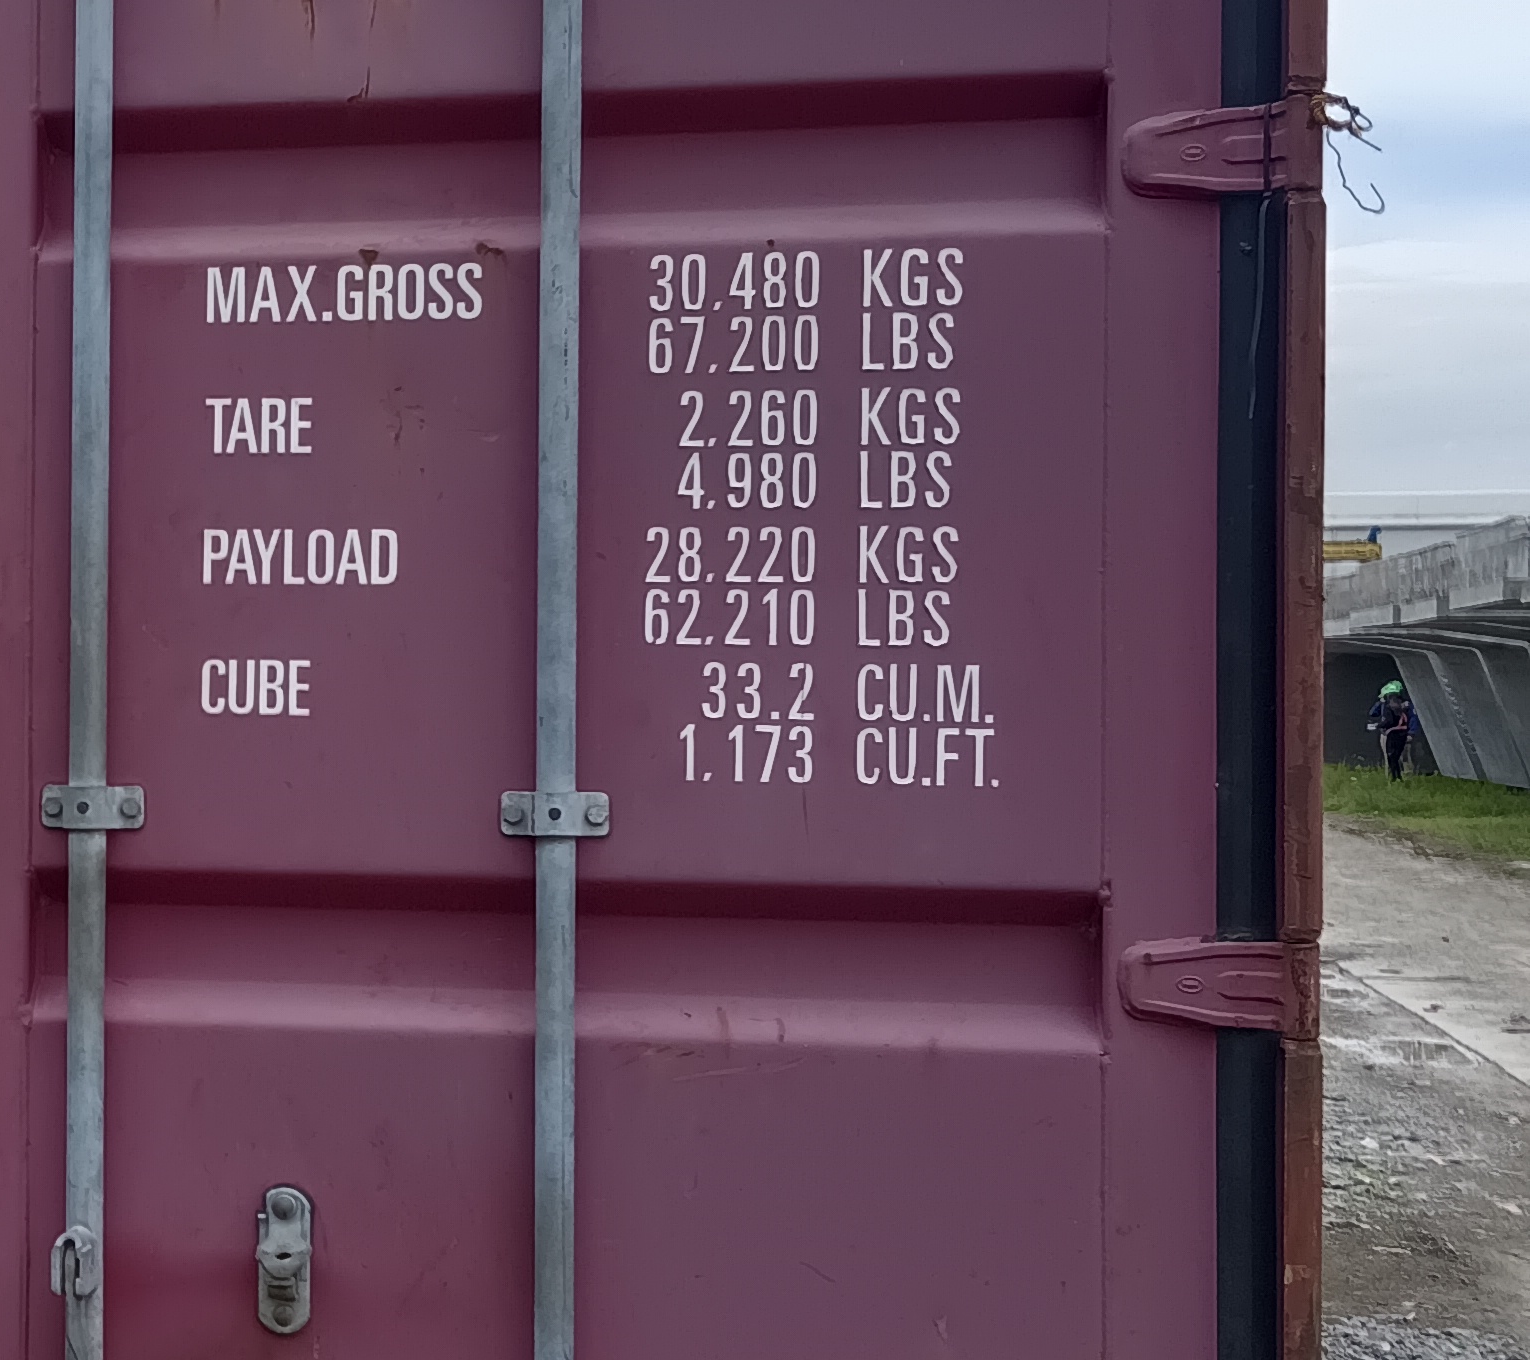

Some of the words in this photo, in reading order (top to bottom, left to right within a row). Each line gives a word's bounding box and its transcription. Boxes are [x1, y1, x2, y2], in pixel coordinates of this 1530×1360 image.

[206, 262, 483, 324] MAX.GROSS
[862, 247, 964, 307] KGS
[861, 312, 955, 370] LBS
[205, 397, 313, 454] TARE
[860, 386, 961, 446] KGS
[860, 450, 952, 509] LBS
[202, 528, 398, 585] PAYLOAD
[859, 525, 959, 584] KGS
[858, 589, 950, 647] LBS
[201, 659, 311, 717] CUBE
[701, 661, 815, 721] 33.2
[857, 663, 994, 724] CU.M.
[856, 726, 999, 788] CU.FT.
